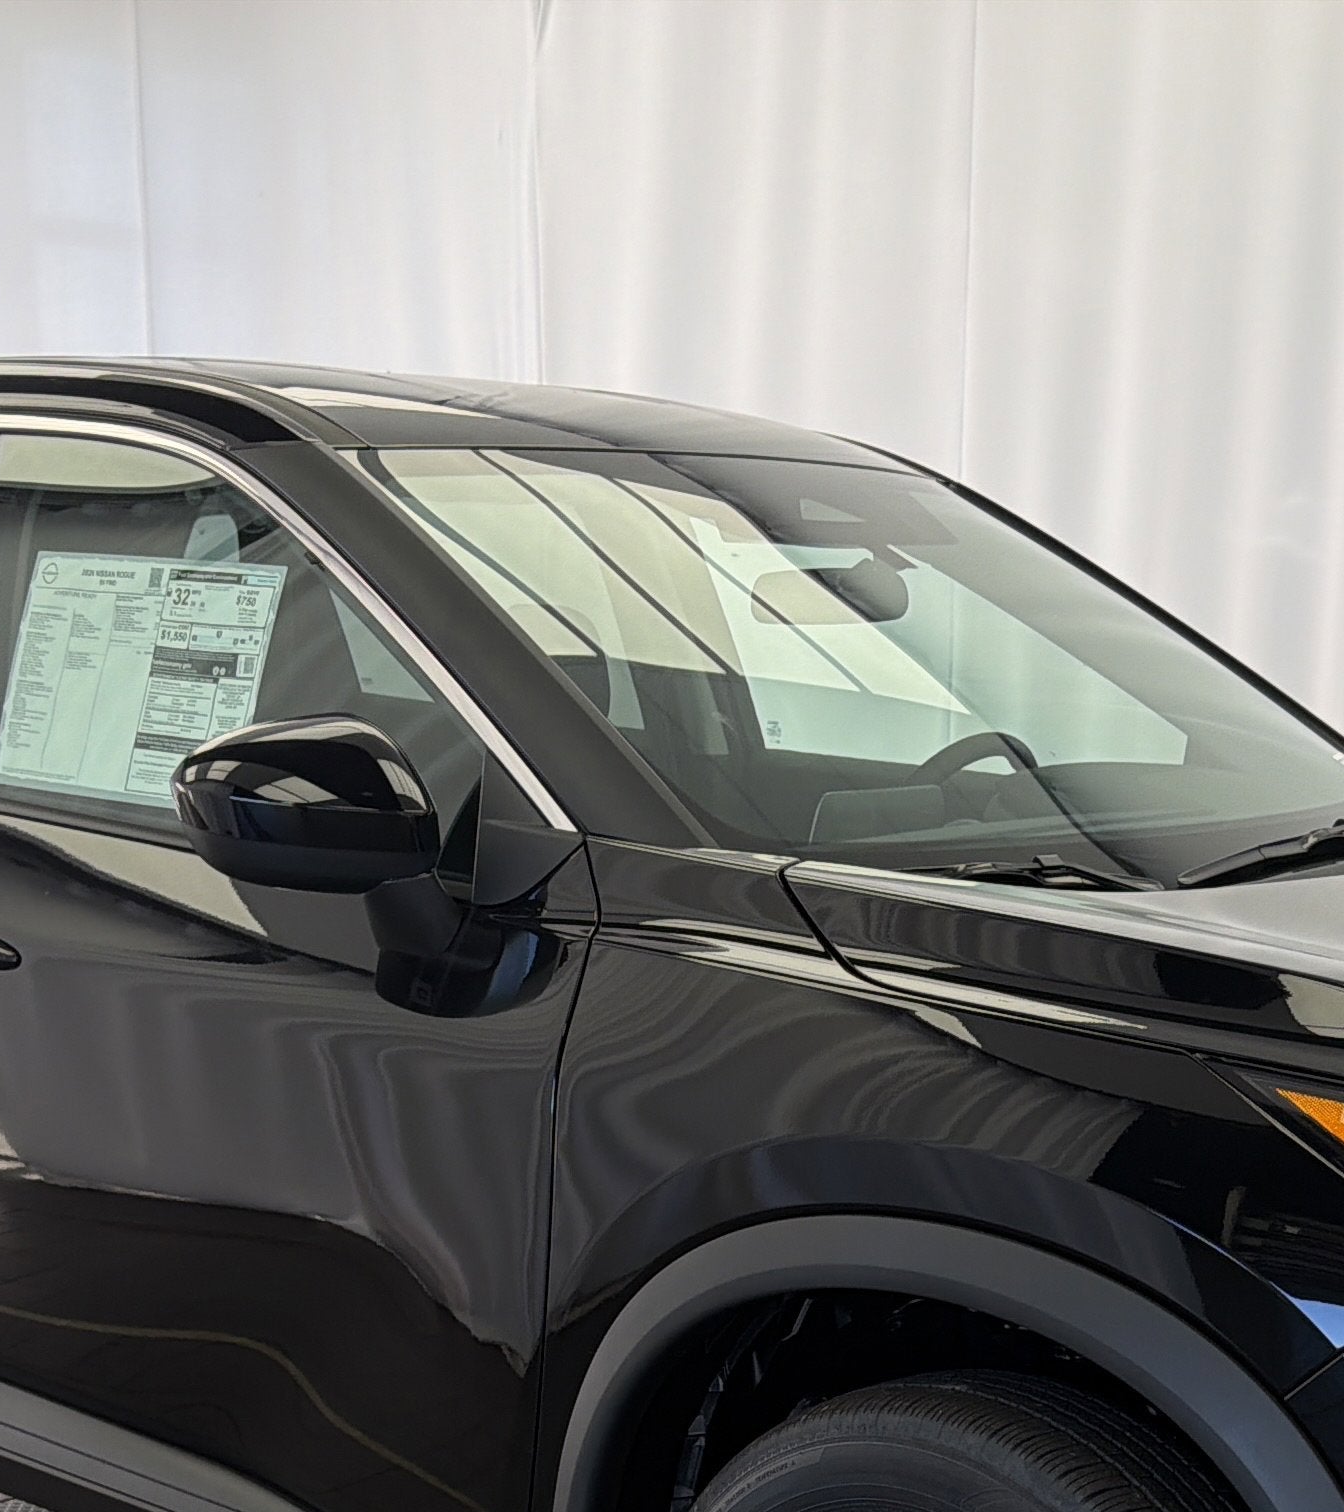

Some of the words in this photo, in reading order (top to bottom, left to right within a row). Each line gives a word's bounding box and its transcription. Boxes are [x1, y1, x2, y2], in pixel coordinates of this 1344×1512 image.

[95, 569, 116, 578] NISSAN
[117, 571, 136, 579] ROGUE
[172, 588, 191, 606] 32
[235, 594, 256, 608] $750
[160, 629, 188, 642] $1,550
